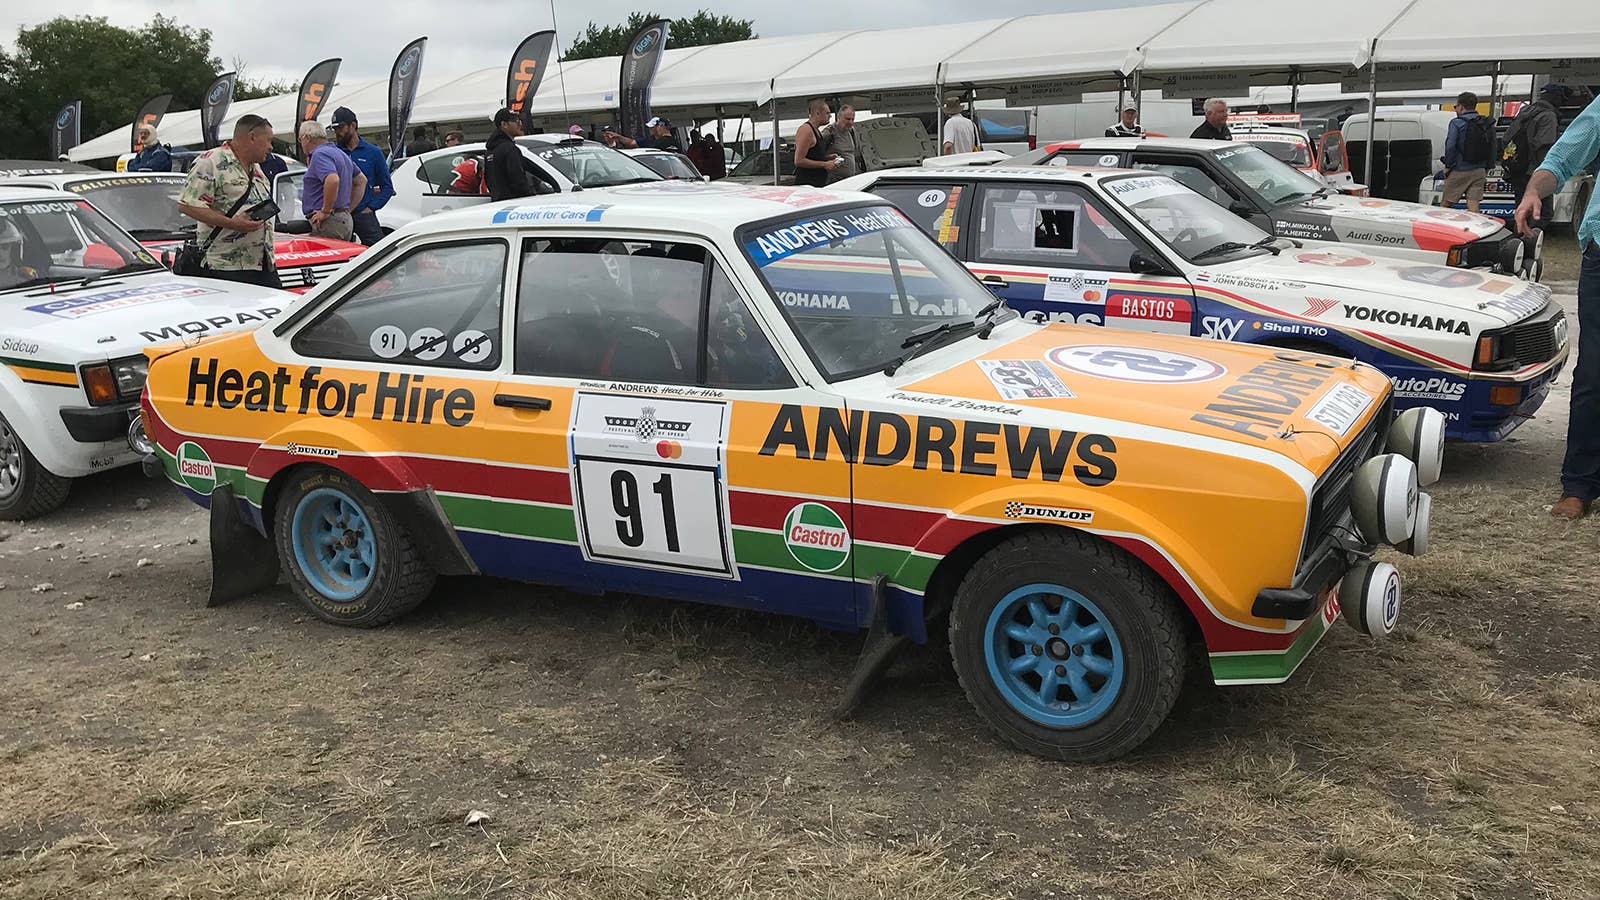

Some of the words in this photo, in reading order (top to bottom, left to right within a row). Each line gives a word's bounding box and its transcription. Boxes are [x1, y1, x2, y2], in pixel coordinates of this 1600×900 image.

[70, 177, 152, 193] RALLYCROSS
[1112, 182, 1134, 195] Audi
[925, 194, 938, 203] 60
[23, 200, 79, 215] SIDCUP
[508, 210, 542, 221] Credit
[542, 211, 558, 220] for
[560, 210, 586, 220] Cars
[755, 217, 849, 260] ANDREWS
[845, 212, 880, 233] Heat
[1346, 230, 1371, 241] Audi
[1374, 233, 1406, 245] Sport
[1213, 277, 1236, 286] JOHN
[1237, 280, 1268, 290] BOSCH
[1121, 299, 1175, 319] BASTOS
[1200, 315, 1246, 342] SKY
[1262, 321, 1300, 334] Shell
[1301, 325, 1328, 337] TMO
[1343, 304, 1472, 337] YOKOHAMA
[1, 338, 39, 355] Sidcup
[381, 333, 397, 350] 91
[185, 357, 291, 413] Heat
[297, 366, 367, 418] for
[372, 371, 476, 427] Hire
[609, 383, 659, 394] ANDREWS
[660, 386, 684, 395] Heat
[697, 389, 725, 398] Hire
[1190, 352, 1342, 441] ANDREWS
[297, 445, 339, 458] DUNLOP
[758, 404, 1119, 487] ANDREWS
[181, 459, 213, 478] Castrol
[610, 469, 681, 553] 91
[1023, 506, 1093, 522] DUNLOP
[790, 525, 846, 549] Castrol
